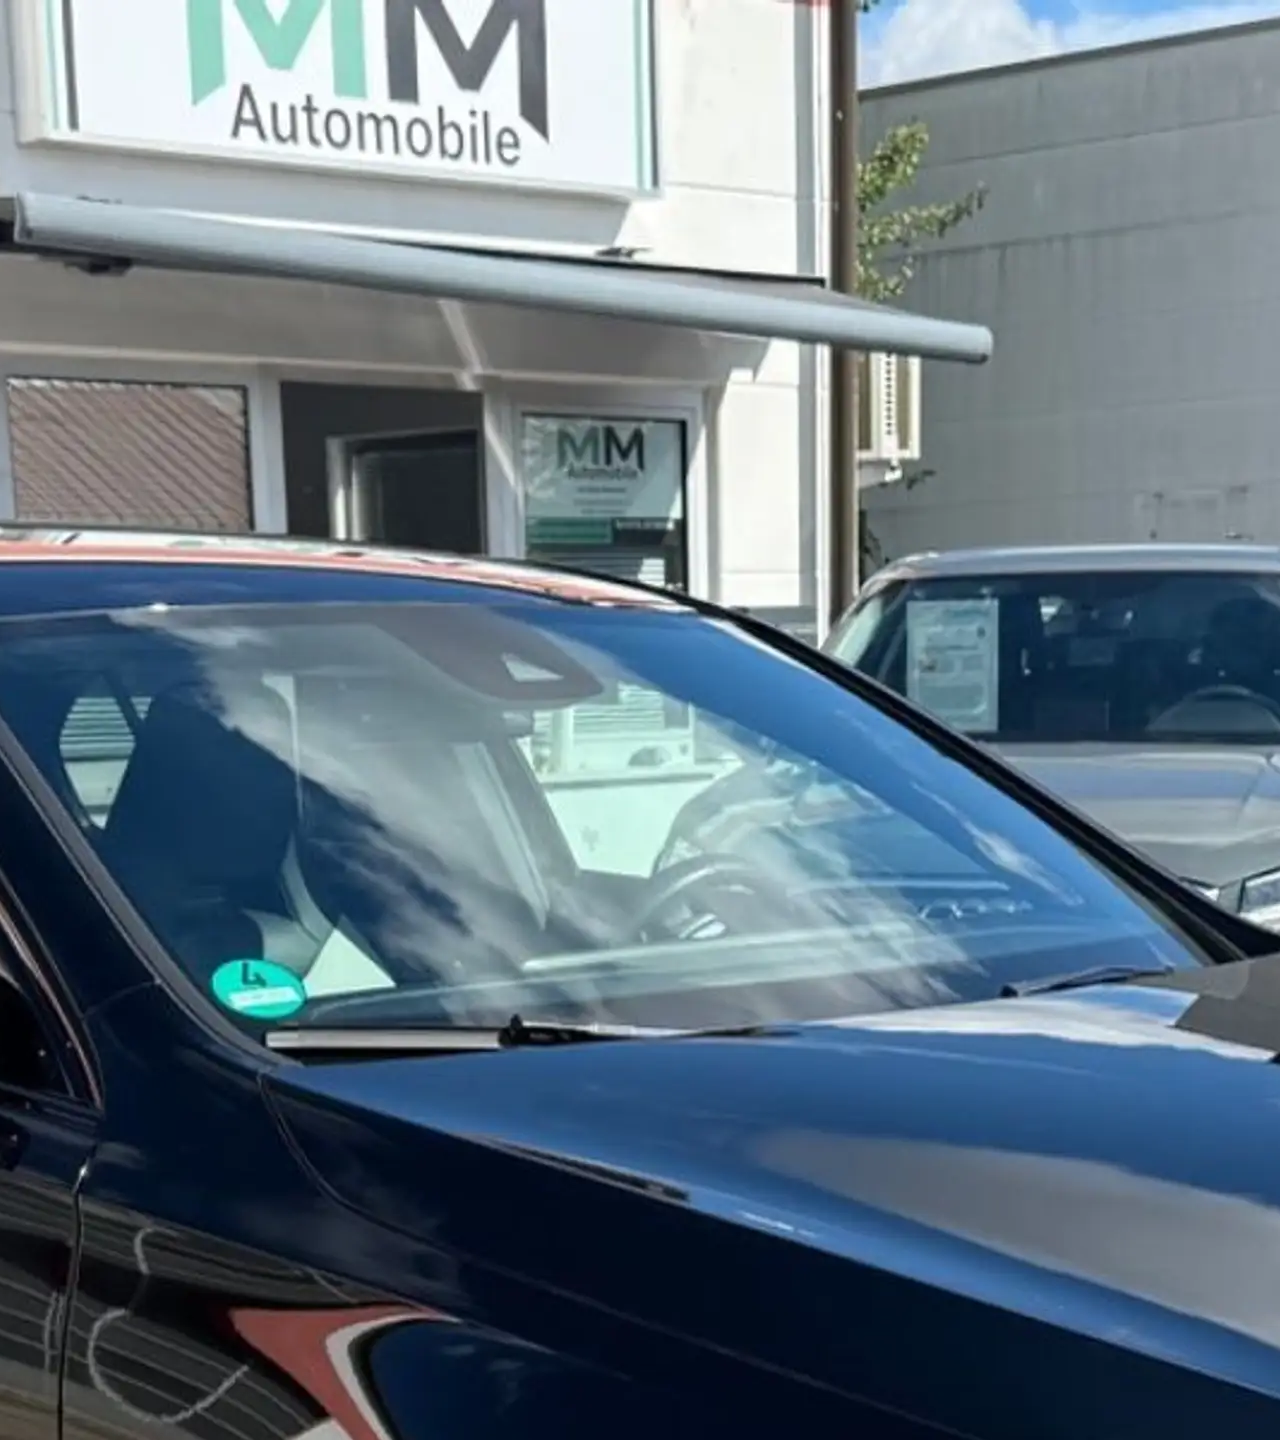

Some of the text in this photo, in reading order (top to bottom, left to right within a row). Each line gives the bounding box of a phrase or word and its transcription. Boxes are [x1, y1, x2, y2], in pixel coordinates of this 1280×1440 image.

[186, 0, 549, 144] MM
[231, 82, 522, 166] Automobile
[556, 425, 646, 473] MM
